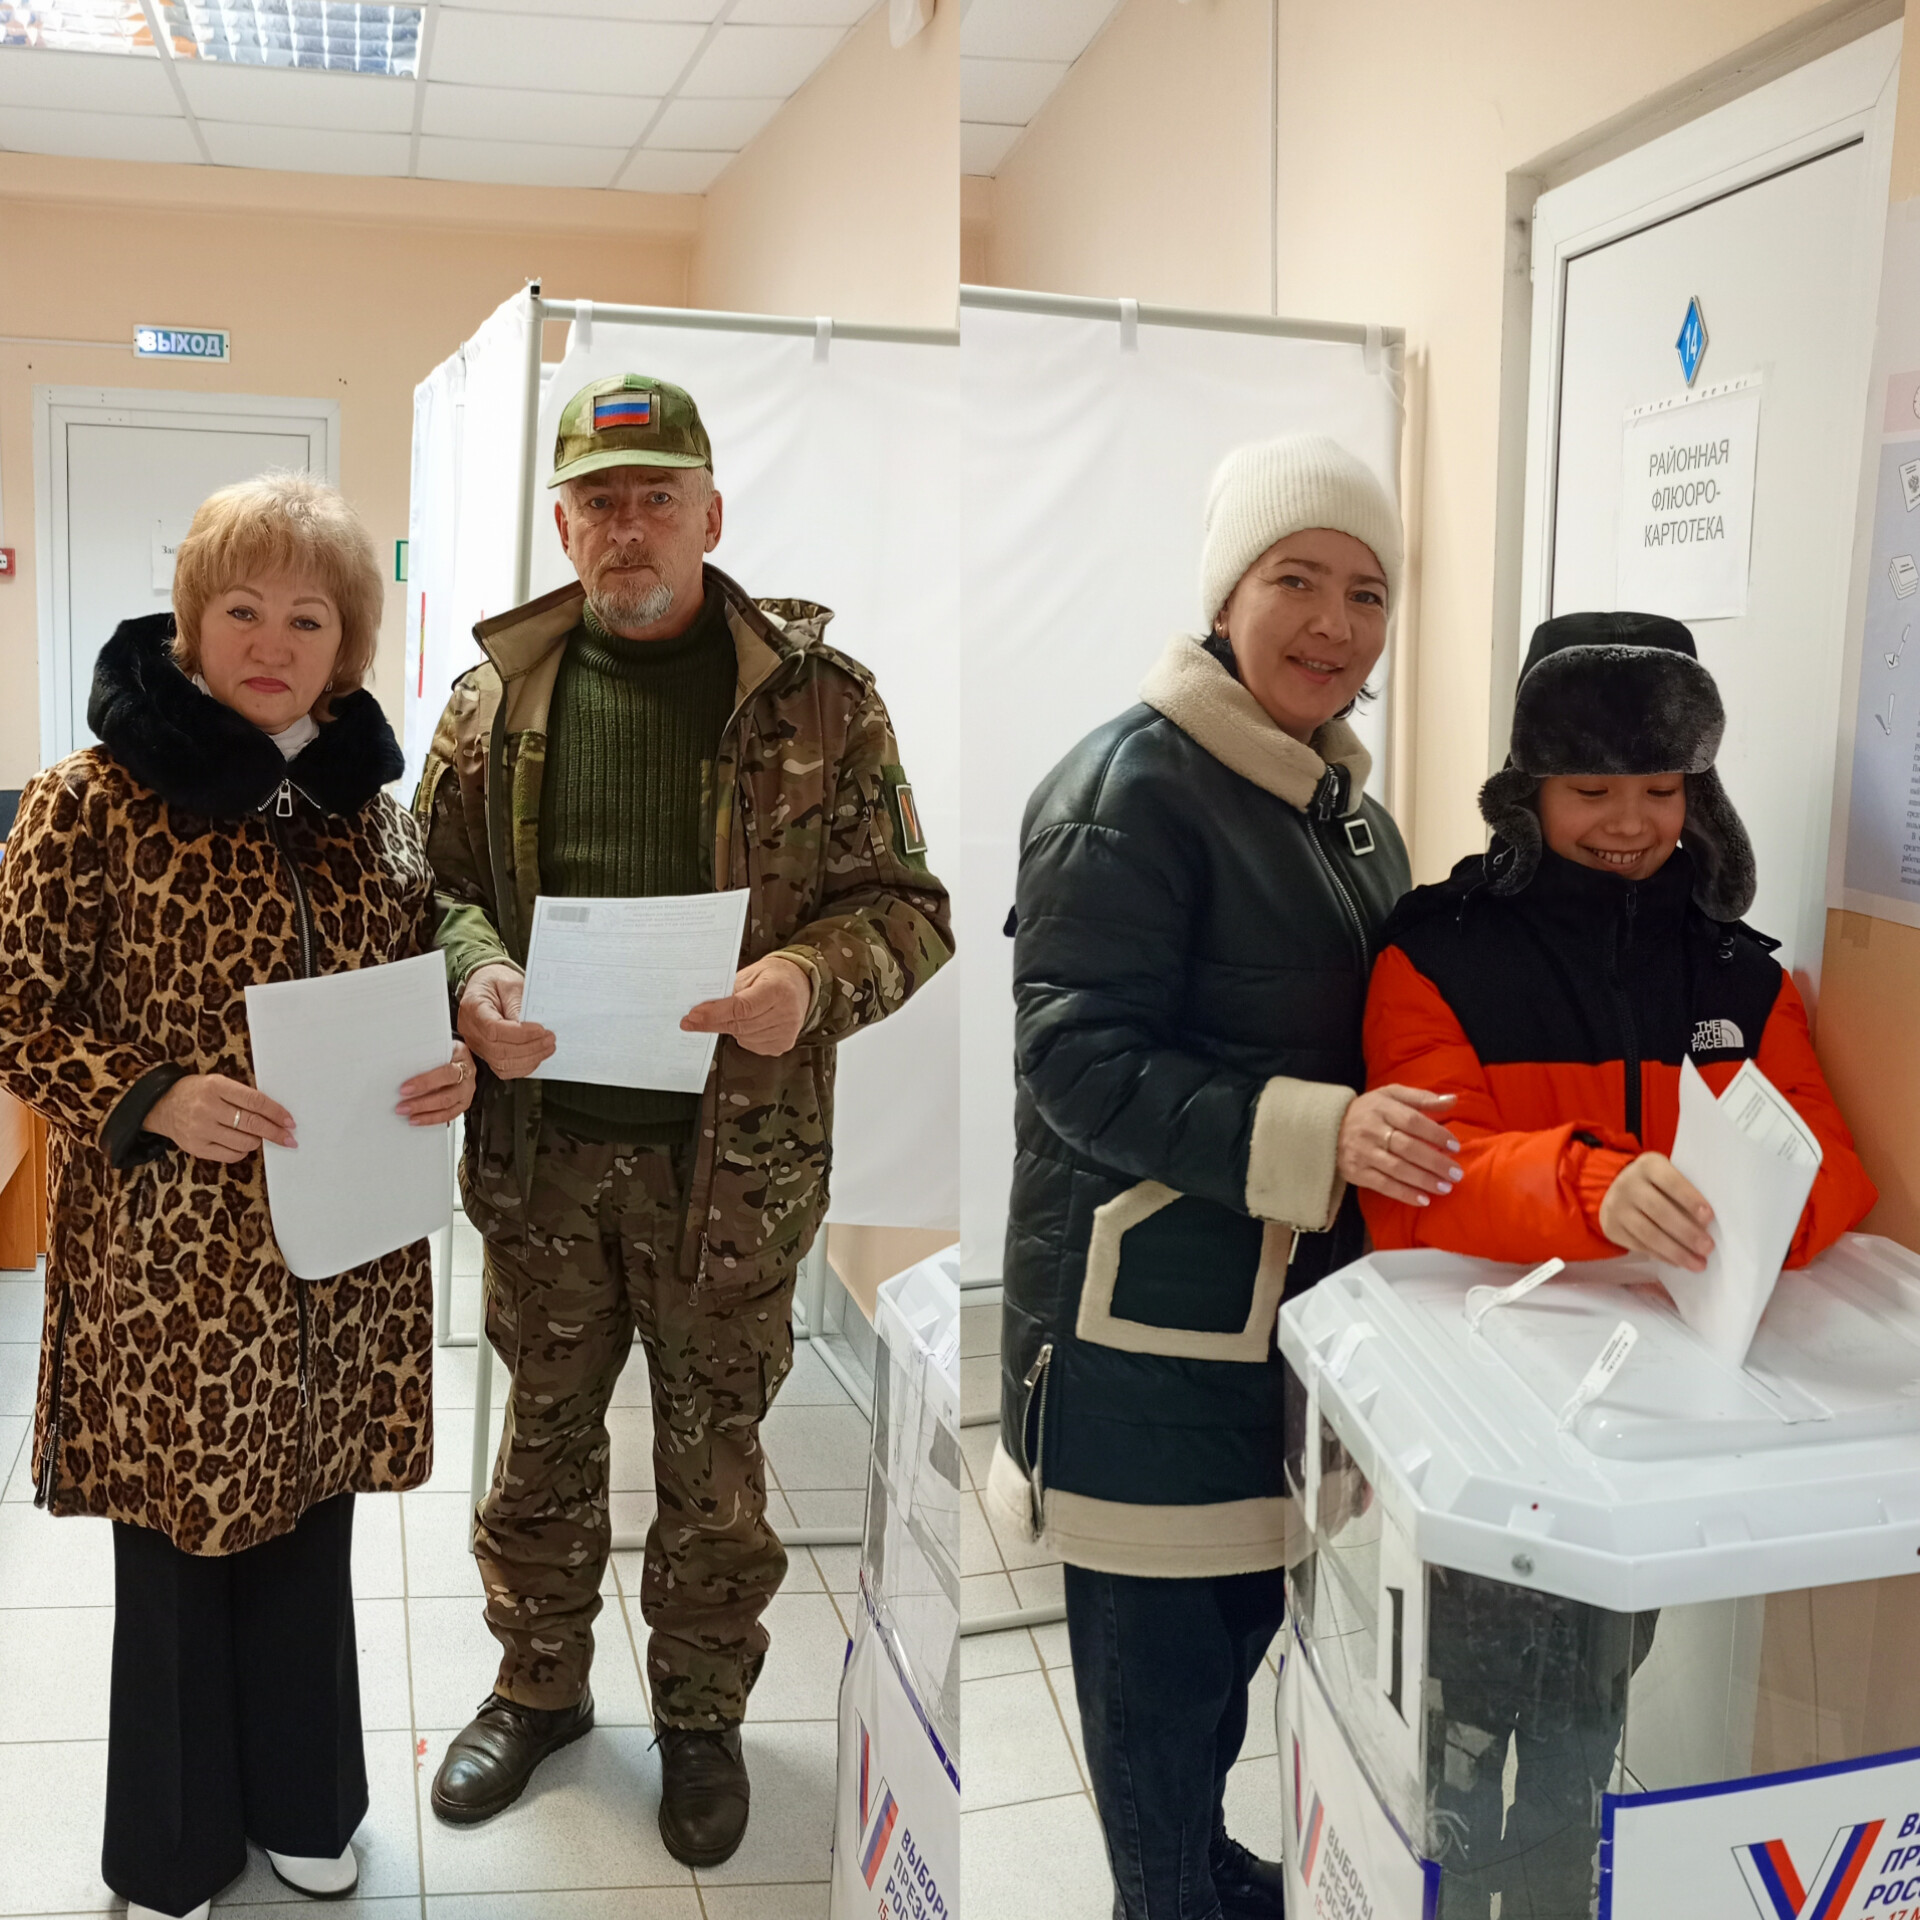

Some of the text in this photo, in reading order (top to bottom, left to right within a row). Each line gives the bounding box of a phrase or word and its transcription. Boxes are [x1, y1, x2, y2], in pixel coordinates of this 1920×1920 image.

[138, 331, 220, 356] ВЫХОД
[1685, 321, 1698, 363] 14
[1649, 439, 1729, 477] РАЙОННАЯ
[1652, 479, 1720, 511] ФЛЮОРО-
[1644, 515, 1724, 547] КАРТОТЕКА
[1695, 1020, 1721, 1031] THE
[1692, 1039, 1722, 1052] FACE
[902, 1827, 948, 1920] ВЫБОР
[1323, 1848, 1361, 1920] ПРЕЗИ
[1863, 1876, 1920, 1910] РОС
